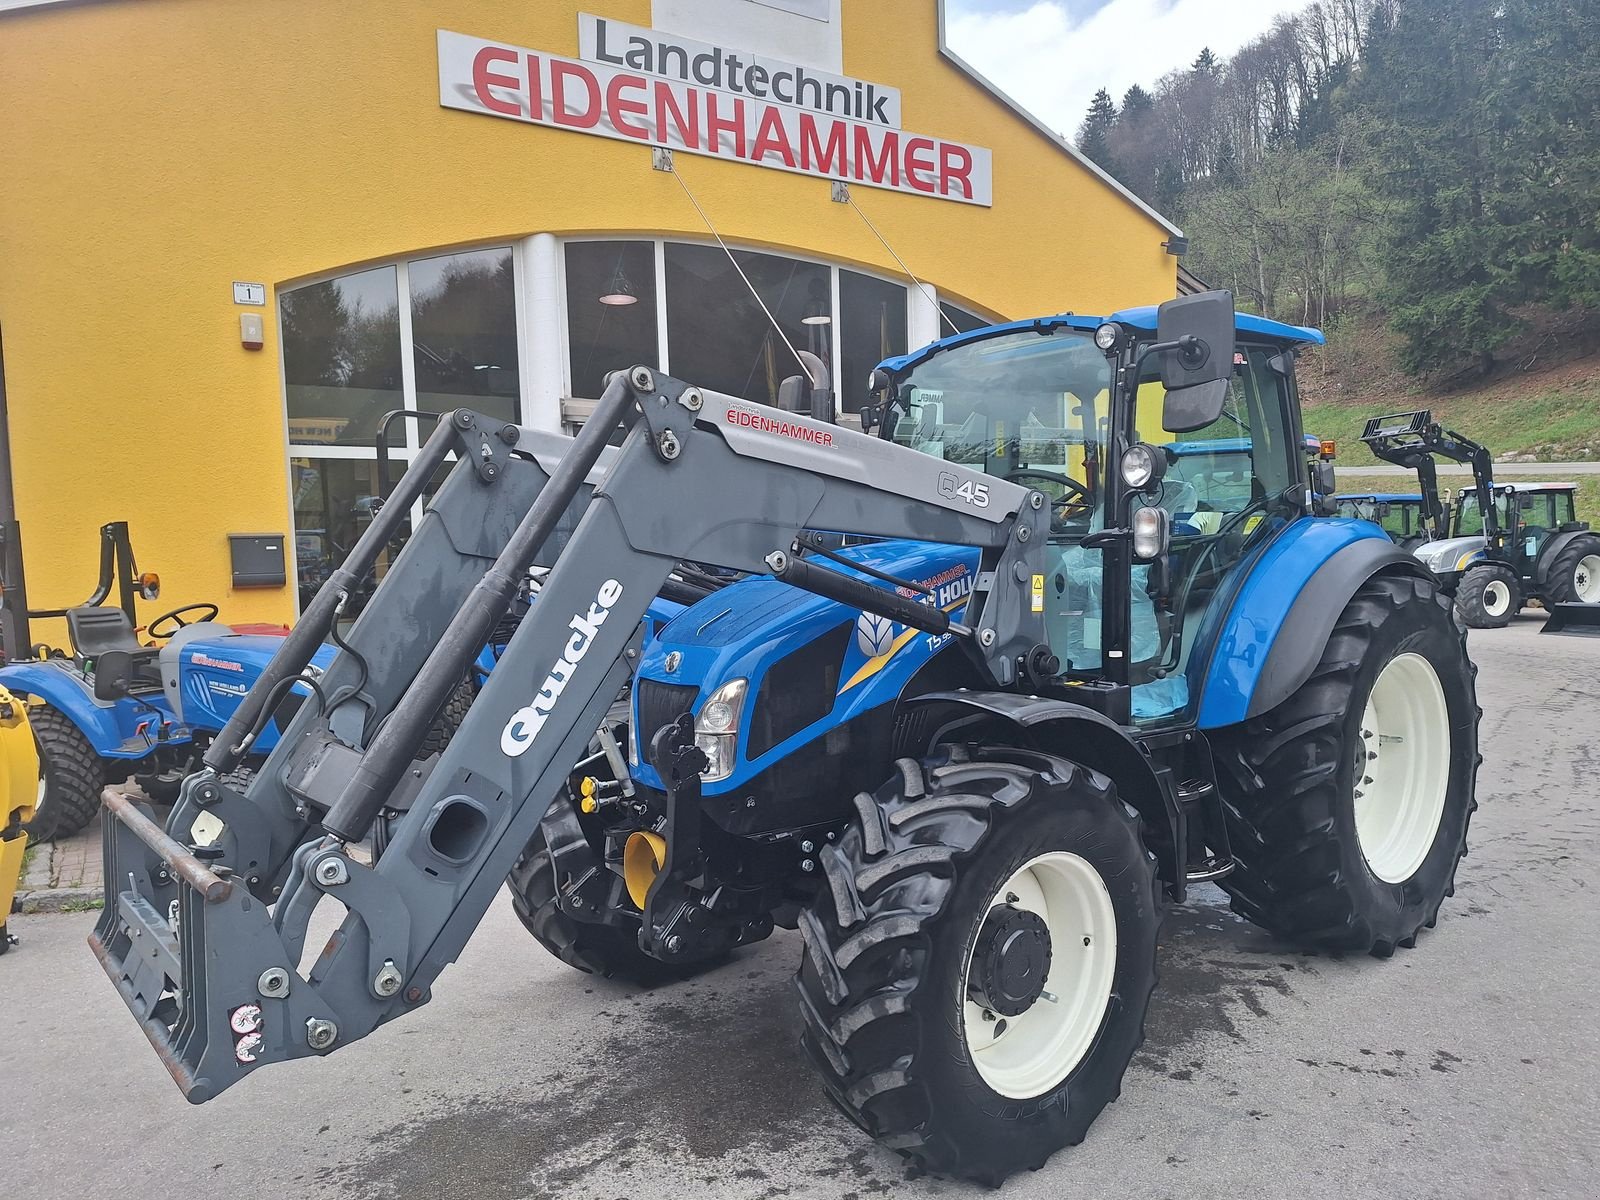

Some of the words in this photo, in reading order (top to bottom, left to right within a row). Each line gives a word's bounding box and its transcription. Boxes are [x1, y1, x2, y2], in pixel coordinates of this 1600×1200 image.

[596, 19, 891, 124] Landtechnik
[472, 46, 973, 199] EIDENHAMMER
[246, 288, 251, 299] 1
[727, 409, 833, 447] EIDENHAMMER
[937, 471, 990, 508] Q45
[940, 575, 973, 606] HOLL
[501, 578, 624, 757] Quicke
